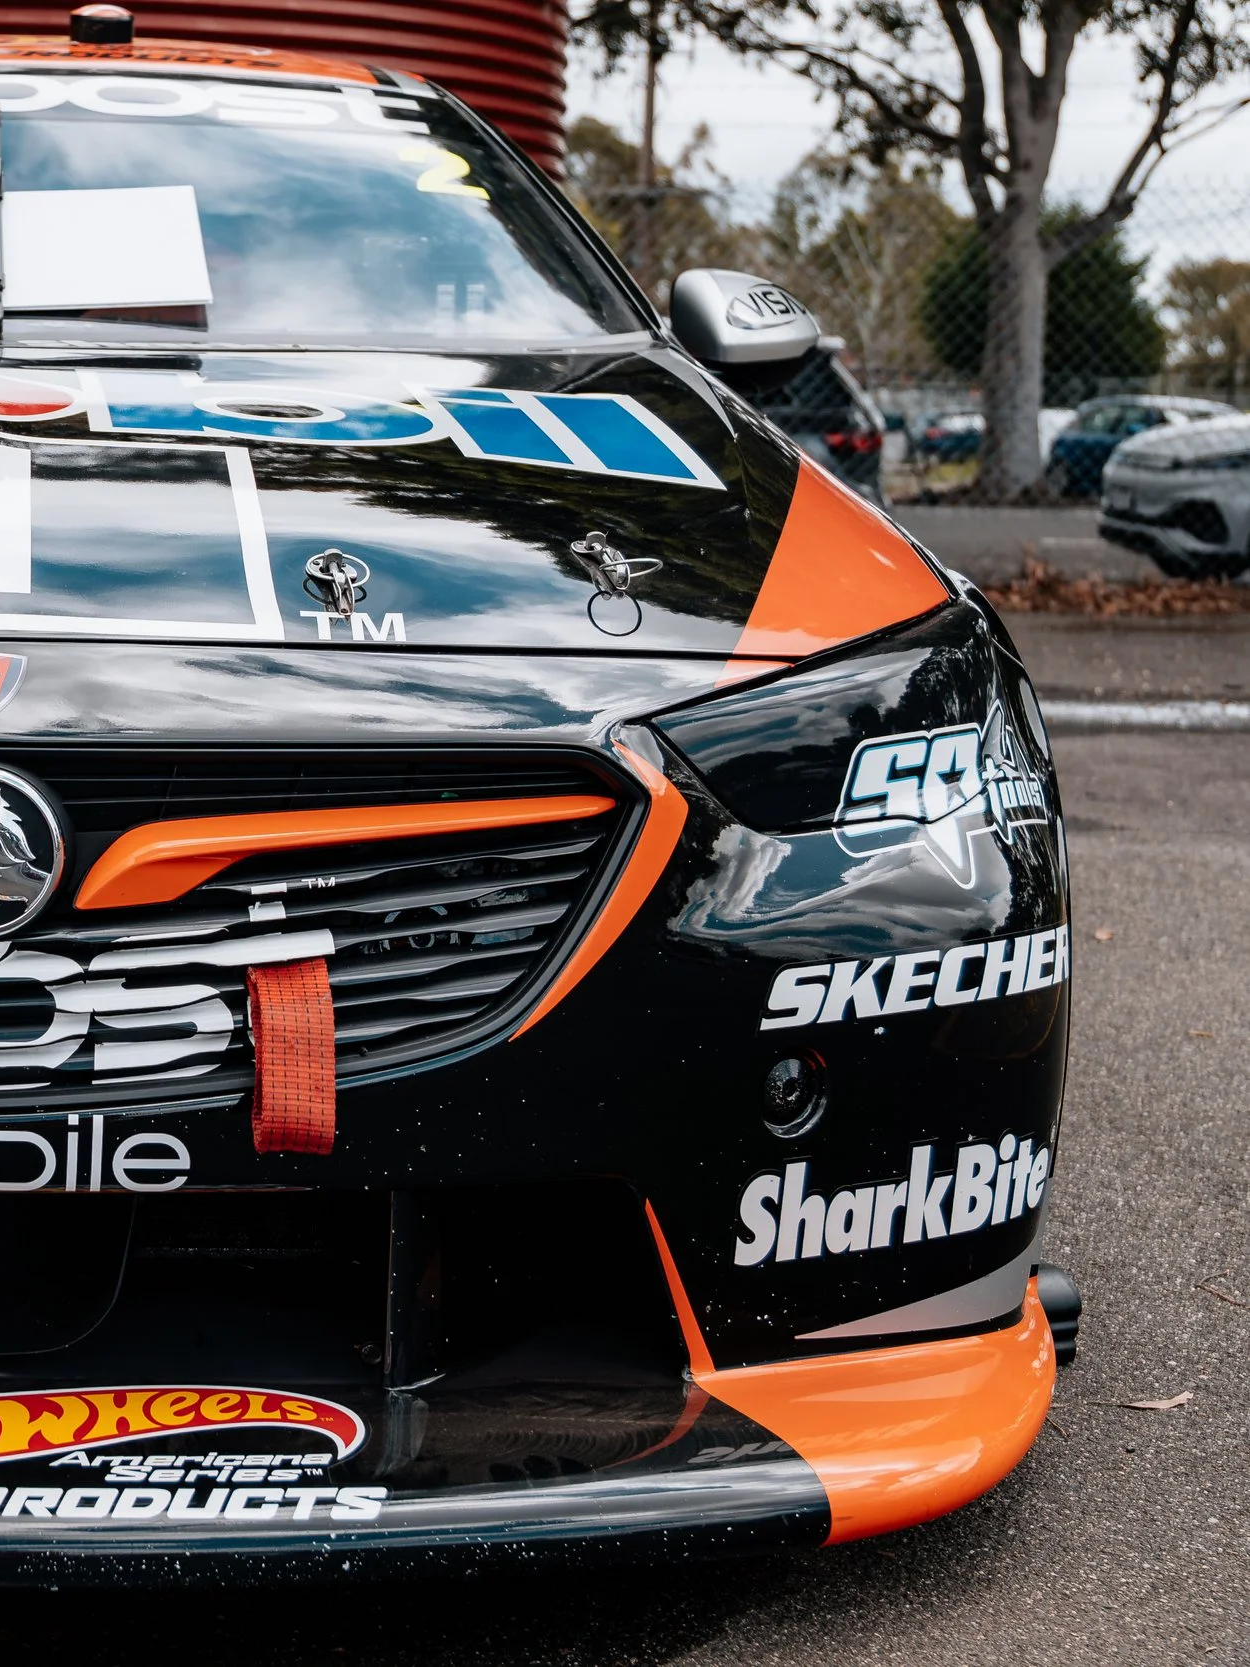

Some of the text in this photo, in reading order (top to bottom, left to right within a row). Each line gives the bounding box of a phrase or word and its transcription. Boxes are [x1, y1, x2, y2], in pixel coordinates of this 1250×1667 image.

[398, 146, 491, 201] 2
[734, 289, 807, 318] VISA
[299, 610, 407, 642] TM
[759, 922, 1070, 1031] SKECHER
[734, 1133, 1049, 1266] SharkBite
[49, 1450, 333, 1467] Americana
[105, 1464, 303, 1483] Series
